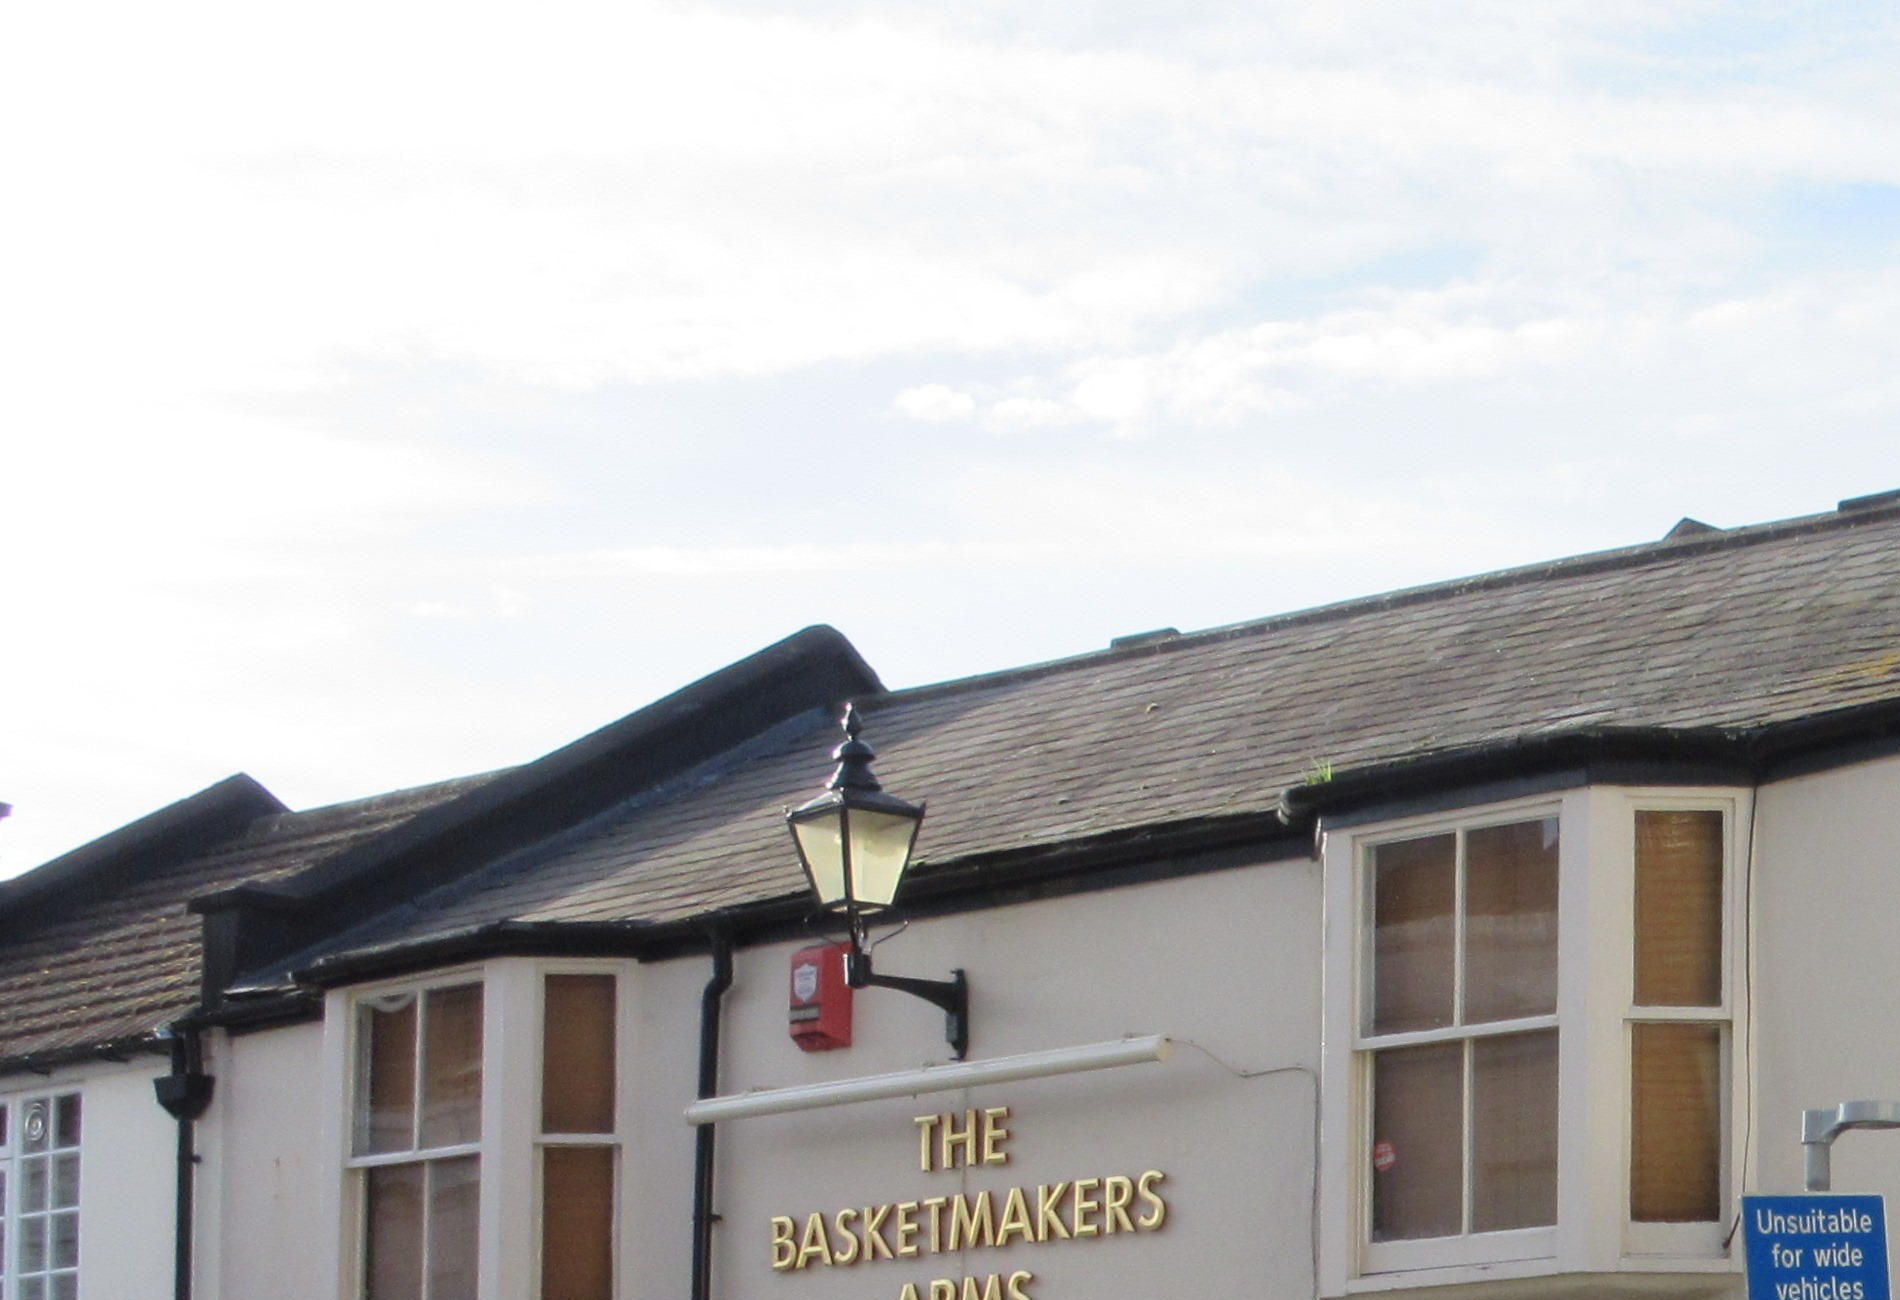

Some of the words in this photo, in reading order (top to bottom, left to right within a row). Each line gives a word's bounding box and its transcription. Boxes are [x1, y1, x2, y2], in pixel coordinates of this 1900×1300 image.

[914, 1106, 1010, 1172] THE
[770, 1169, 1167, 1272] BASKETMAKERS
[1757, 1208, 1873, 1235] Unsuitable
[1772, 1243, 1803, 1268] for
[1813, 1242, 1863, 1267] wide
